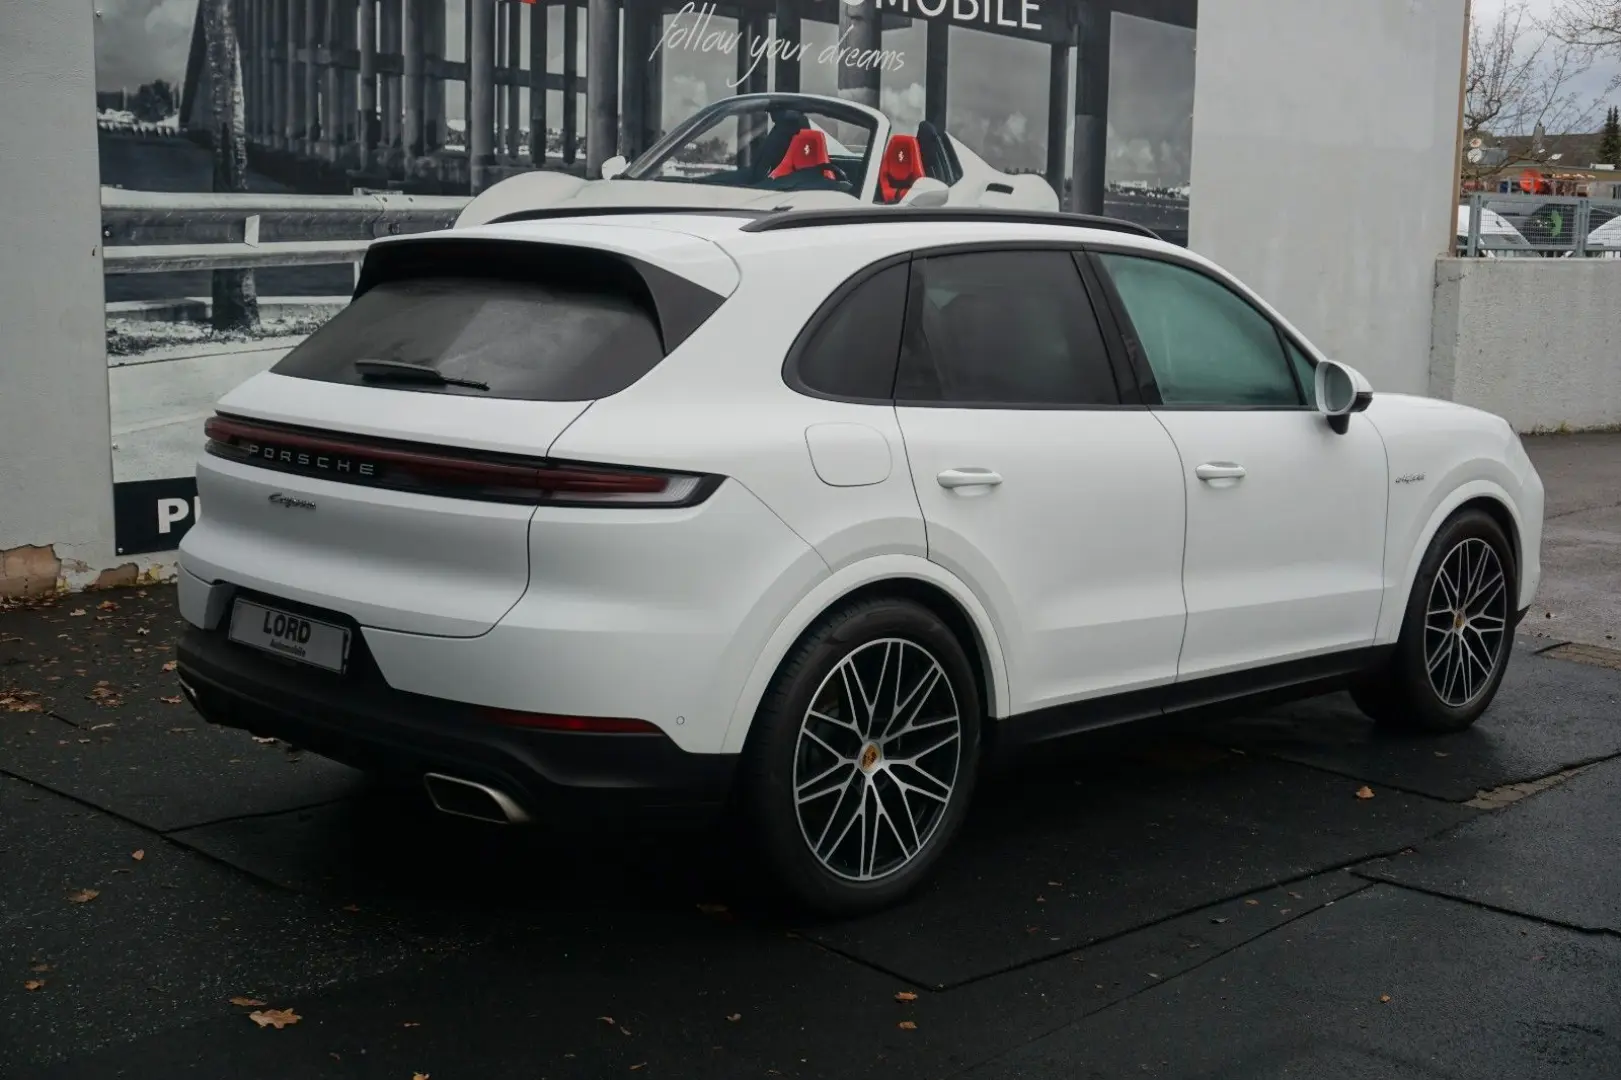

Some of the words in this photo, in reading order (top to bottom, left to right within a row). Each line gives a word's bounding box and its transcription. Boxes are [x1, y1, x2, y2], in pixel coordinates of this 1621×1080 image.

[648, 1, 743, 62] follow
[726, 31, 810, 88] your
[817, 24, 906, 72] dreams
[248, 444, 374, 476] PORSCHE
[263, 611, 312, 644] LORD
